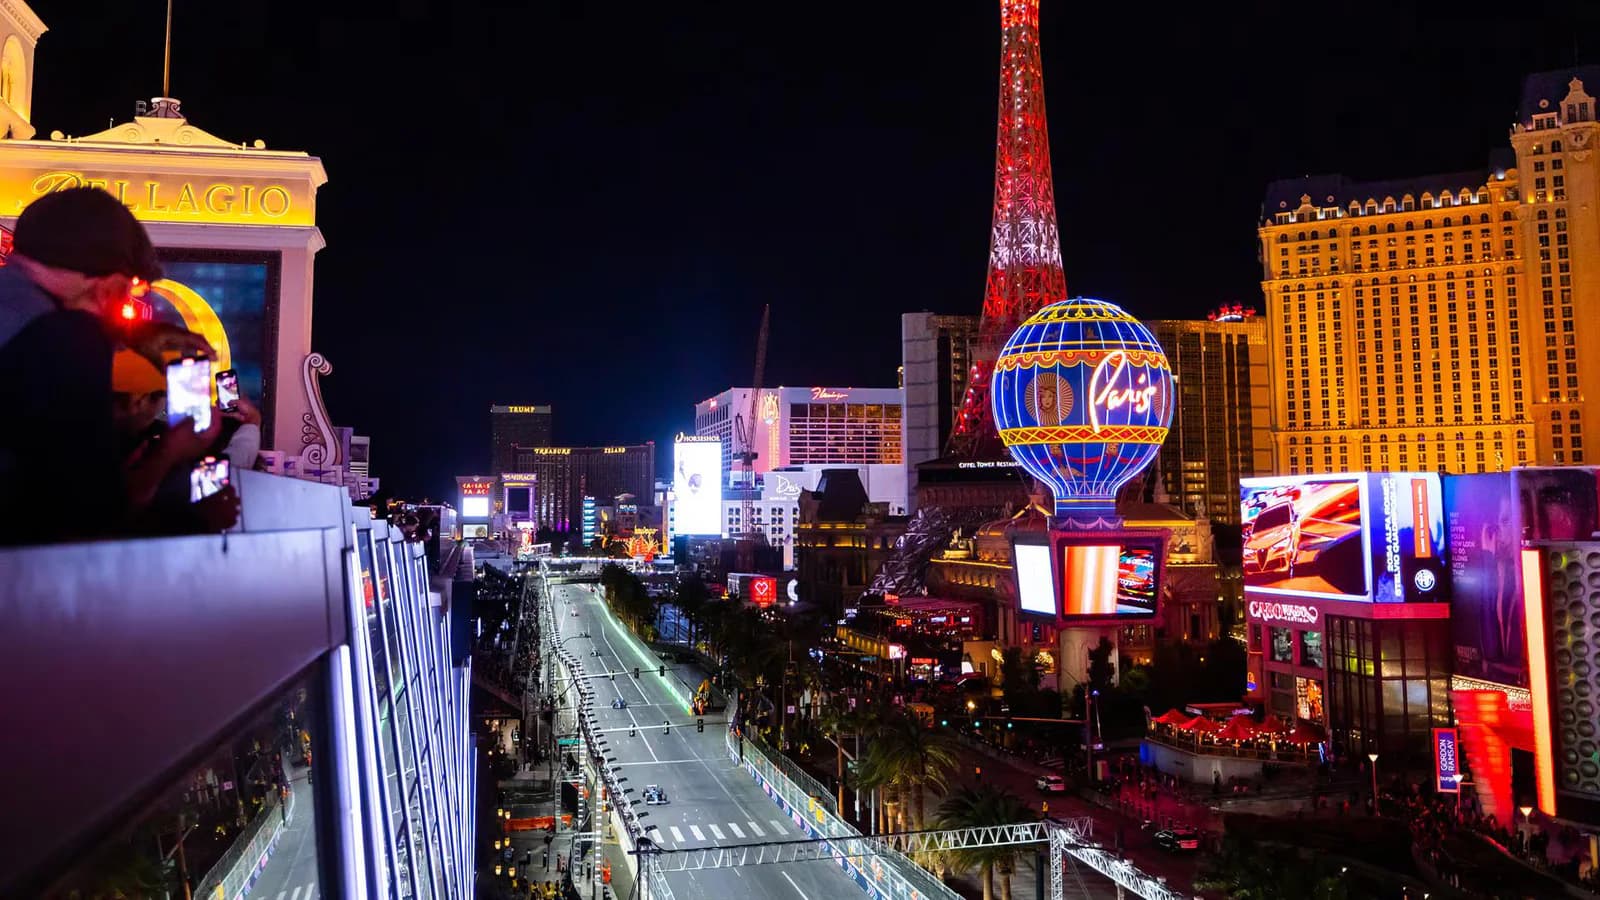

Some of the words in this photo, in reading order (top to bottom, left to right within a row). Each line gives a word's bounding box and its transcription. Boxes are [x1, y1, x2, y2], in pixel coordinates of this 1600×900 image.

[31, 171, 291, 217] BLLAGIO
[811, 387, 848, 400] Flamingo
[1089, 350, 1157, 433] Paris
[1382, 478, 1391, 515] ROMEO
[1385, 517, 1393, 543] ALFA
[1391, 556, 1401, 597] STELVIO
[1440, 740, 1448, 771] GORDON
[1446, 740, 1455, 772] RAMSAY
